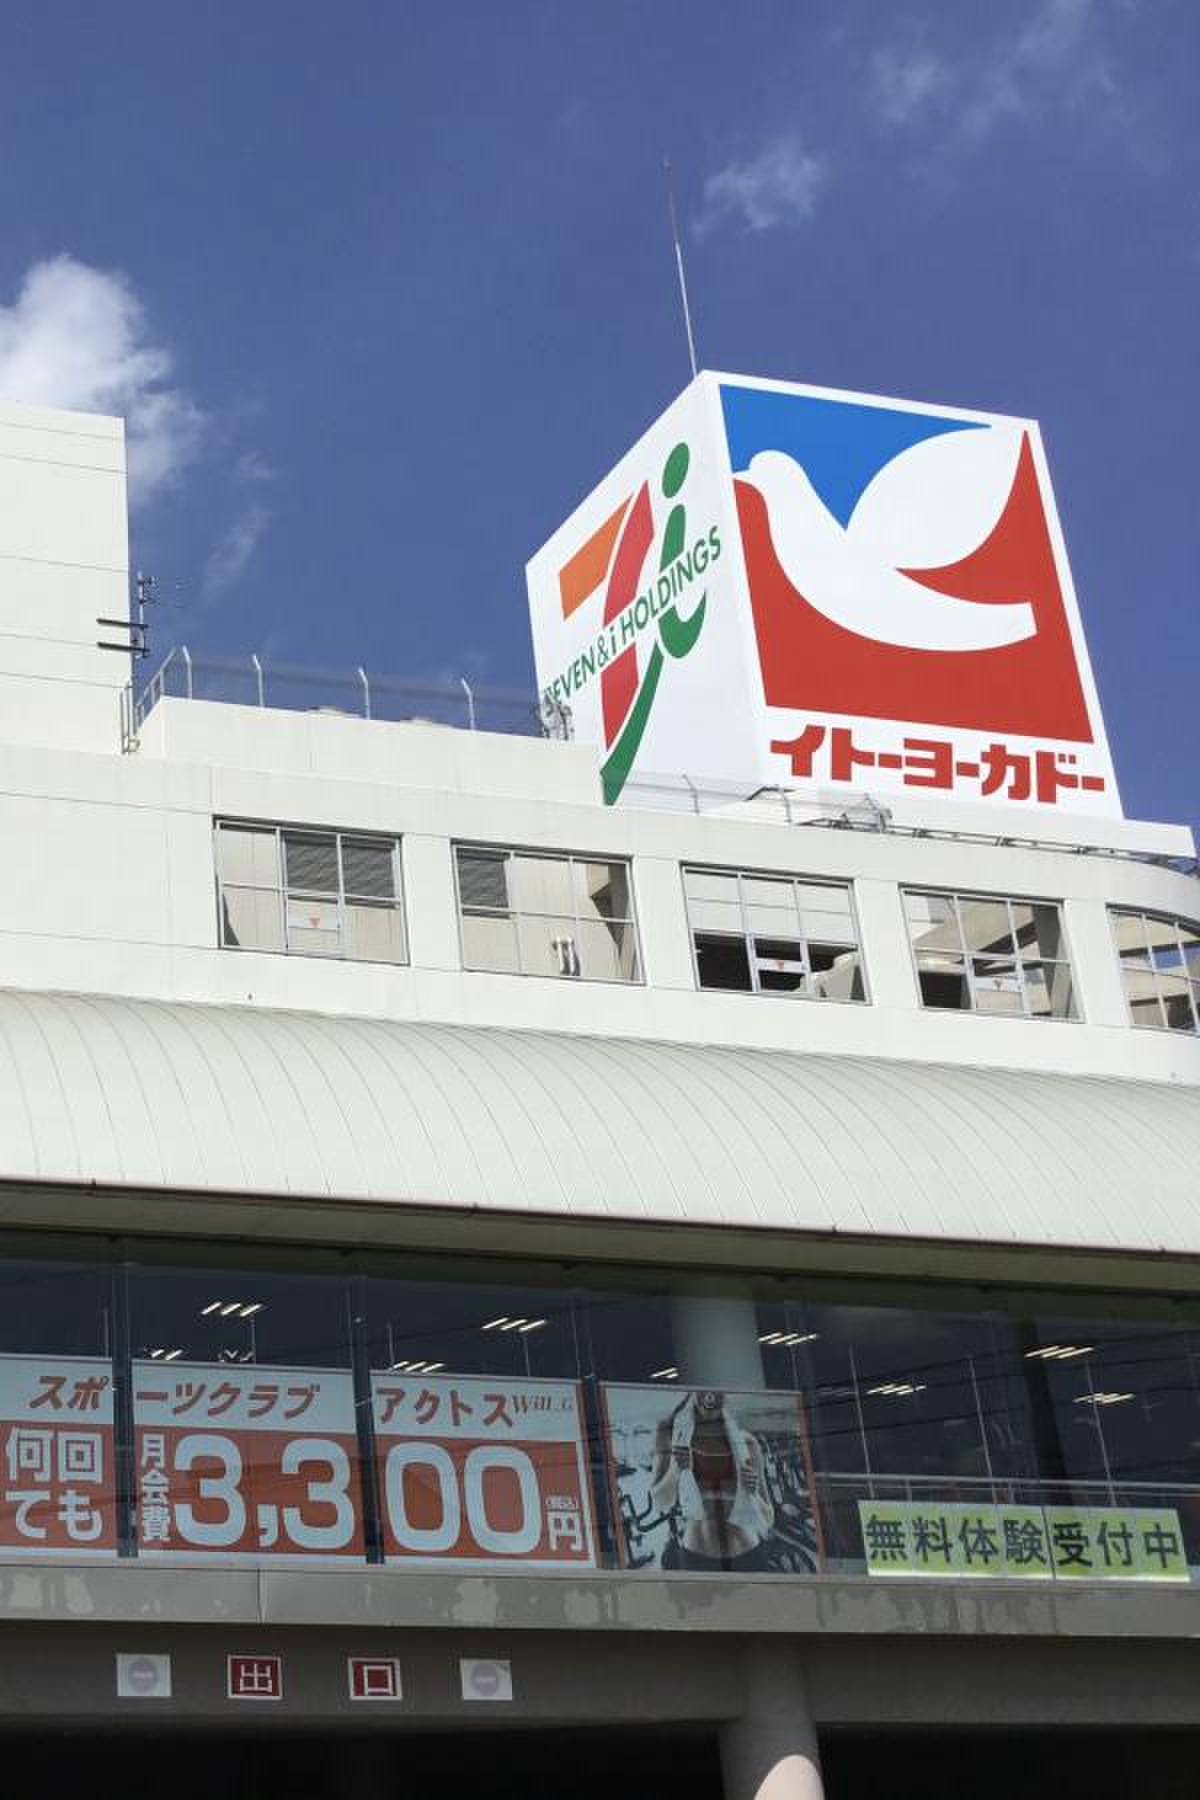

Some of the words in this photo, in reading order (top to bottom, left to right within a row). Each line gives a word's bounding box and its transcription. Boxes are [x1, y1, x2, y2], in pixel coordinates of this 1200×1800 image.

[620, 525, 721, 646] HOLDINGS
[770, 725, 1106, 804] イトーヨーカドー
[140, 1432, 173, 1544] 月会費
[864, 1513, 1182, 1570] 無料体験受付中
